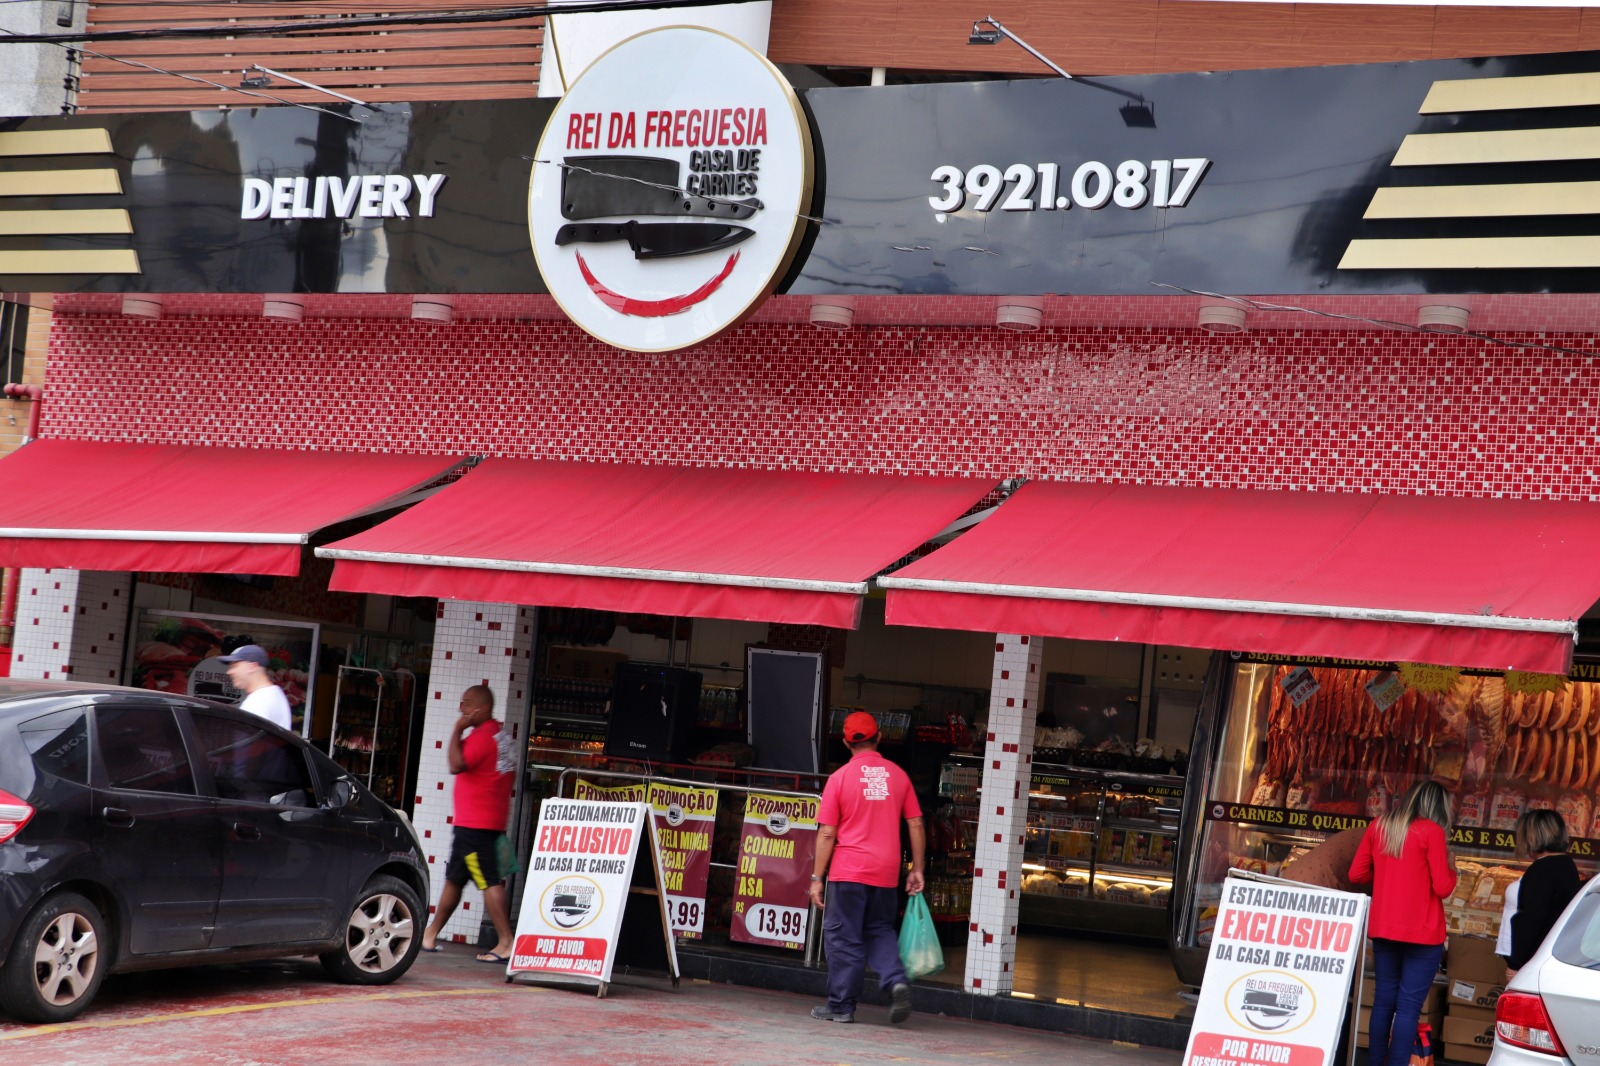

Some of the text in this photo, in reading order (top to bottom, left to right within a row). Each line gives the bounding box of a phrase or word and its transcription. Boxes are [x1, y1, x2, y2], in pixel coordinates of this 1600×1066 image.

[566, 107, 768, 149] REI DA FREGUESIA
[689, 149, 761, 172] CASA DE
[241, 173, 447, 219] DELIVERY
[686, 172, 758, 197] CARNES
[928, 157, 1211, 213] 3921.0817
[651, 788, 714, 813] PROMOÇÃO
[749, 795, 817, 821] PROMOÇÃO
[544, 804, 637, 824] ESTACIONAMENTO
[1229, 805, 1373, 830] CARNES DE QUALID
[537, 825, 633, 856] EXCLUSIVO
[680, 831, 709, 852] MINGA
[744, 834, 795, 859] COXINHA
[1479, 831, 1490, 845] E
[1495, 833, 1516, 848] SA
[1569, 841, 1596, 856] AS.
[534, 856, 626, 874] DA CASA DE CARNES
[660, 850, 686, 870] ECIAL
[740, 855, 757, 875] DA
[662, 870, 684, 891] SAR
[738, 876, 763, 898] ASA
[1228, 885, 1358, 918] ESTACIONAMENTO
[735, 901, 802, 937] R$ 13,99
[1220, 908, 1354, 953] EXCLUSIVO
[536, 938, 585, 956] POR FAVOR
[1215, 943, 1345, 975] DA CASA DE CARNES
[513, 954, 602, 973] RESPEITE NOSSO ESPAÇO
[1246, 978, 1303, 995] REI DA FREGUESIA
[1221, 1038, 1292, 1064] POR FAVOR
